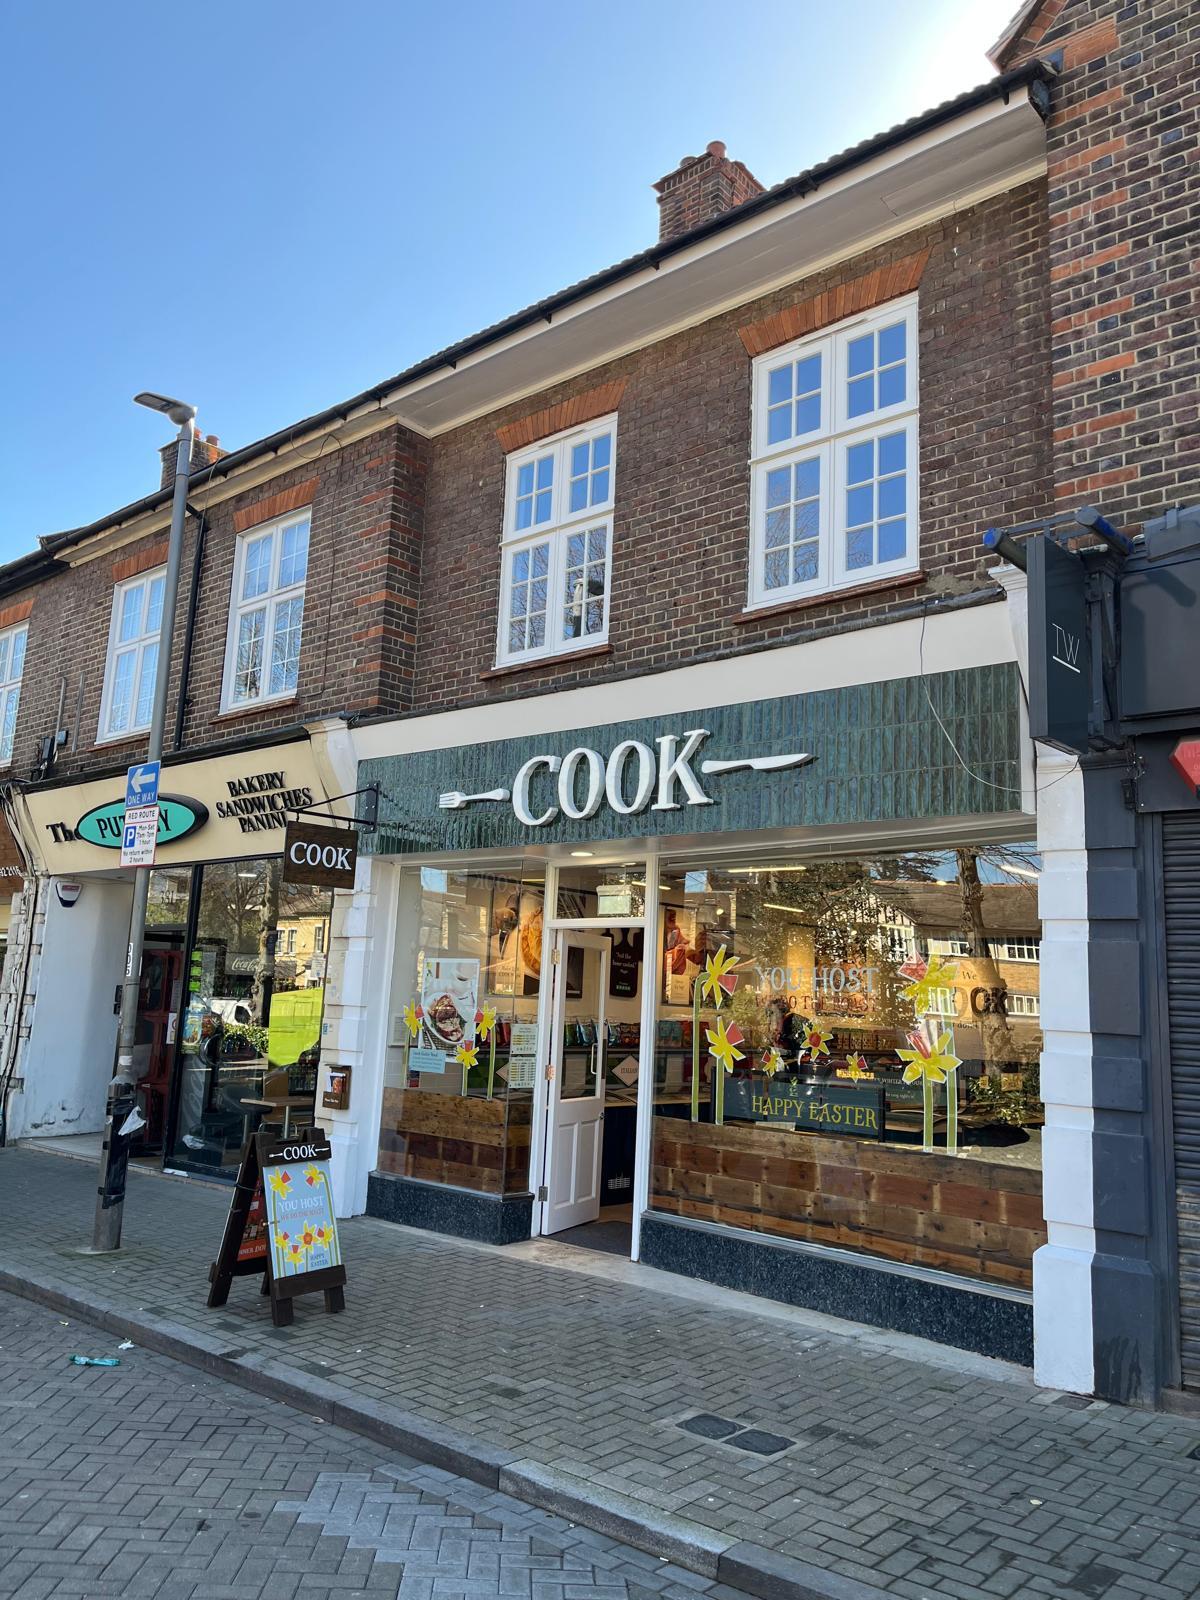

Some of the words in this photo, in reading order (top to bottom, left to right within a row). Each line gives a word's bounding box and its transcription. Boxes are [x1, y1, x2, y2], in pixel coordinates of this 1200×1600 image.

[1052, 623, 1080, 665] TW
[226, 771, 286, 798] BAKERY
[512, 728, 714, 827] COOK
[128, 795, 140, 805] ONE
[142, 791, 155, 801] WAY
[216, 787, 313, 819] SANDWICHES
[129, 812, 138, 820] RED
[140, 810, 155, 818] ROUTE
[238, 811, 288, 833] PANINI
[290, 841, 353, 870] COOK
[753, 965, 804, 992] YOU
[812, 966, 880, 993] HOST
[751, 1095, 805, 1118] HAPPY
[808, 1102, 879, 1130] EASTER
[283, 1144, 318, 1160] COOK
[278, 1199, 298, 1213] YOU
[299, 1196, 324, 1210] HOST
